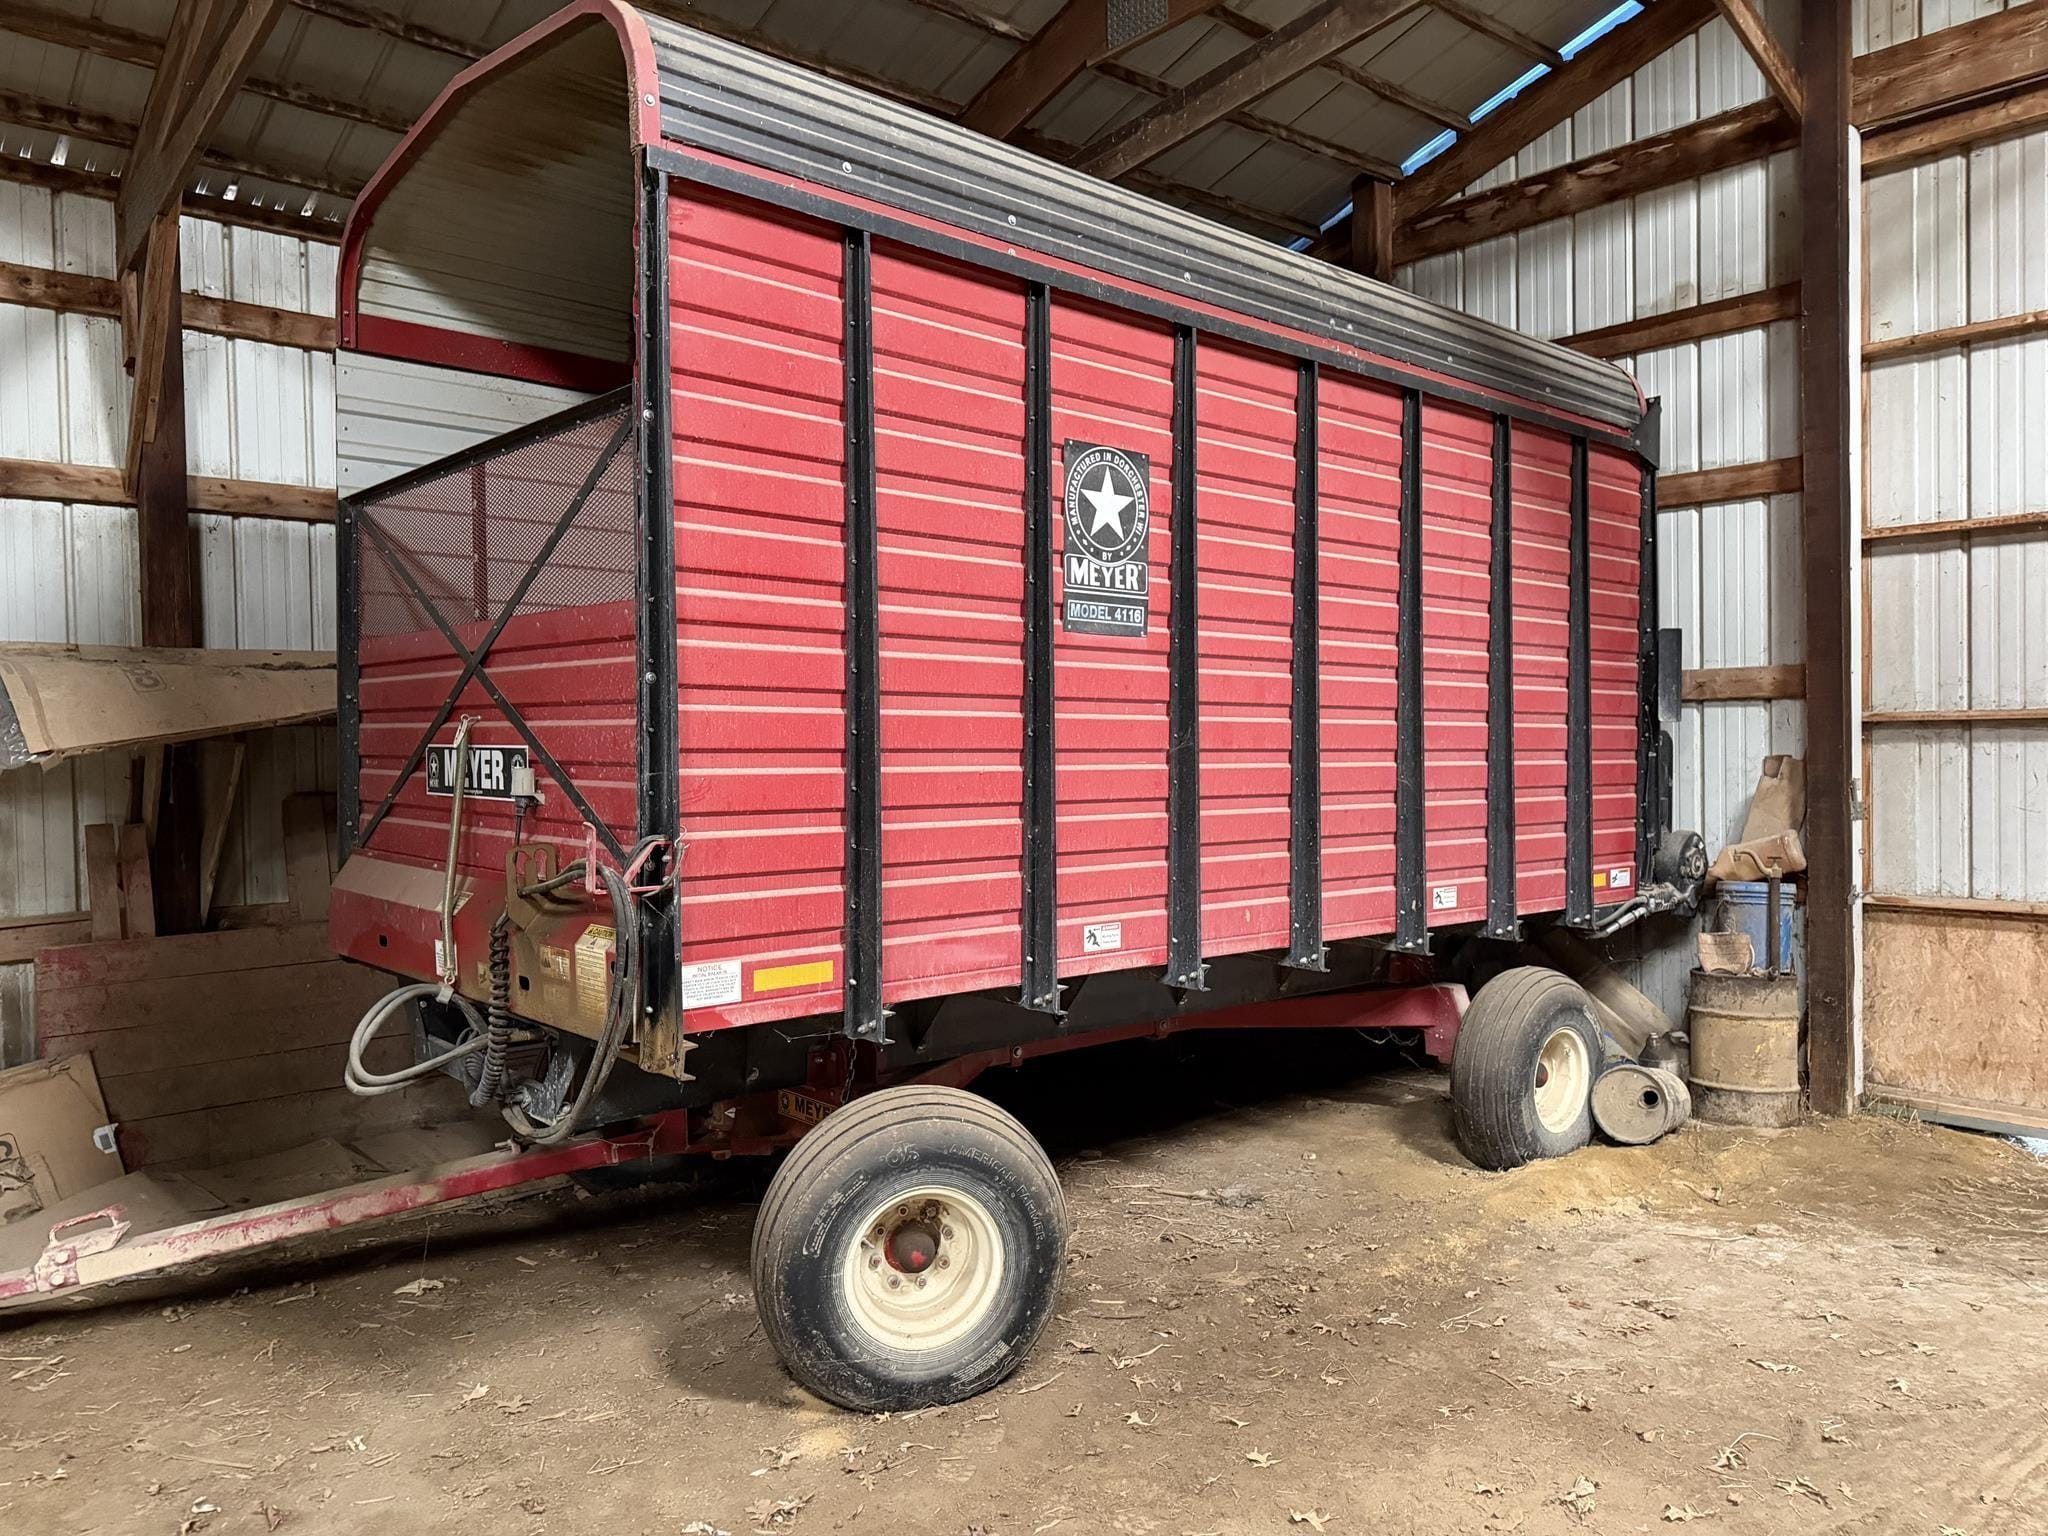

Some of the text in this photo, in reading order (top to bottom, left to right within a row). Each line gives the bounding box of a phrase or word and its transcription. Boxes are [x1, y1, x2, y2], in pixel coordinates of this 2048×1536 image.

[1068, 452, 1146, 536] MANUFACTURED IN DORCHESTER WI
[1102, 551, 1113, 561] BY
[1070, 557, 1140, 591] MEYER
[1070, 603, 1142, 623] MODEL 4116
[444, 749, 504, 790] MYER
